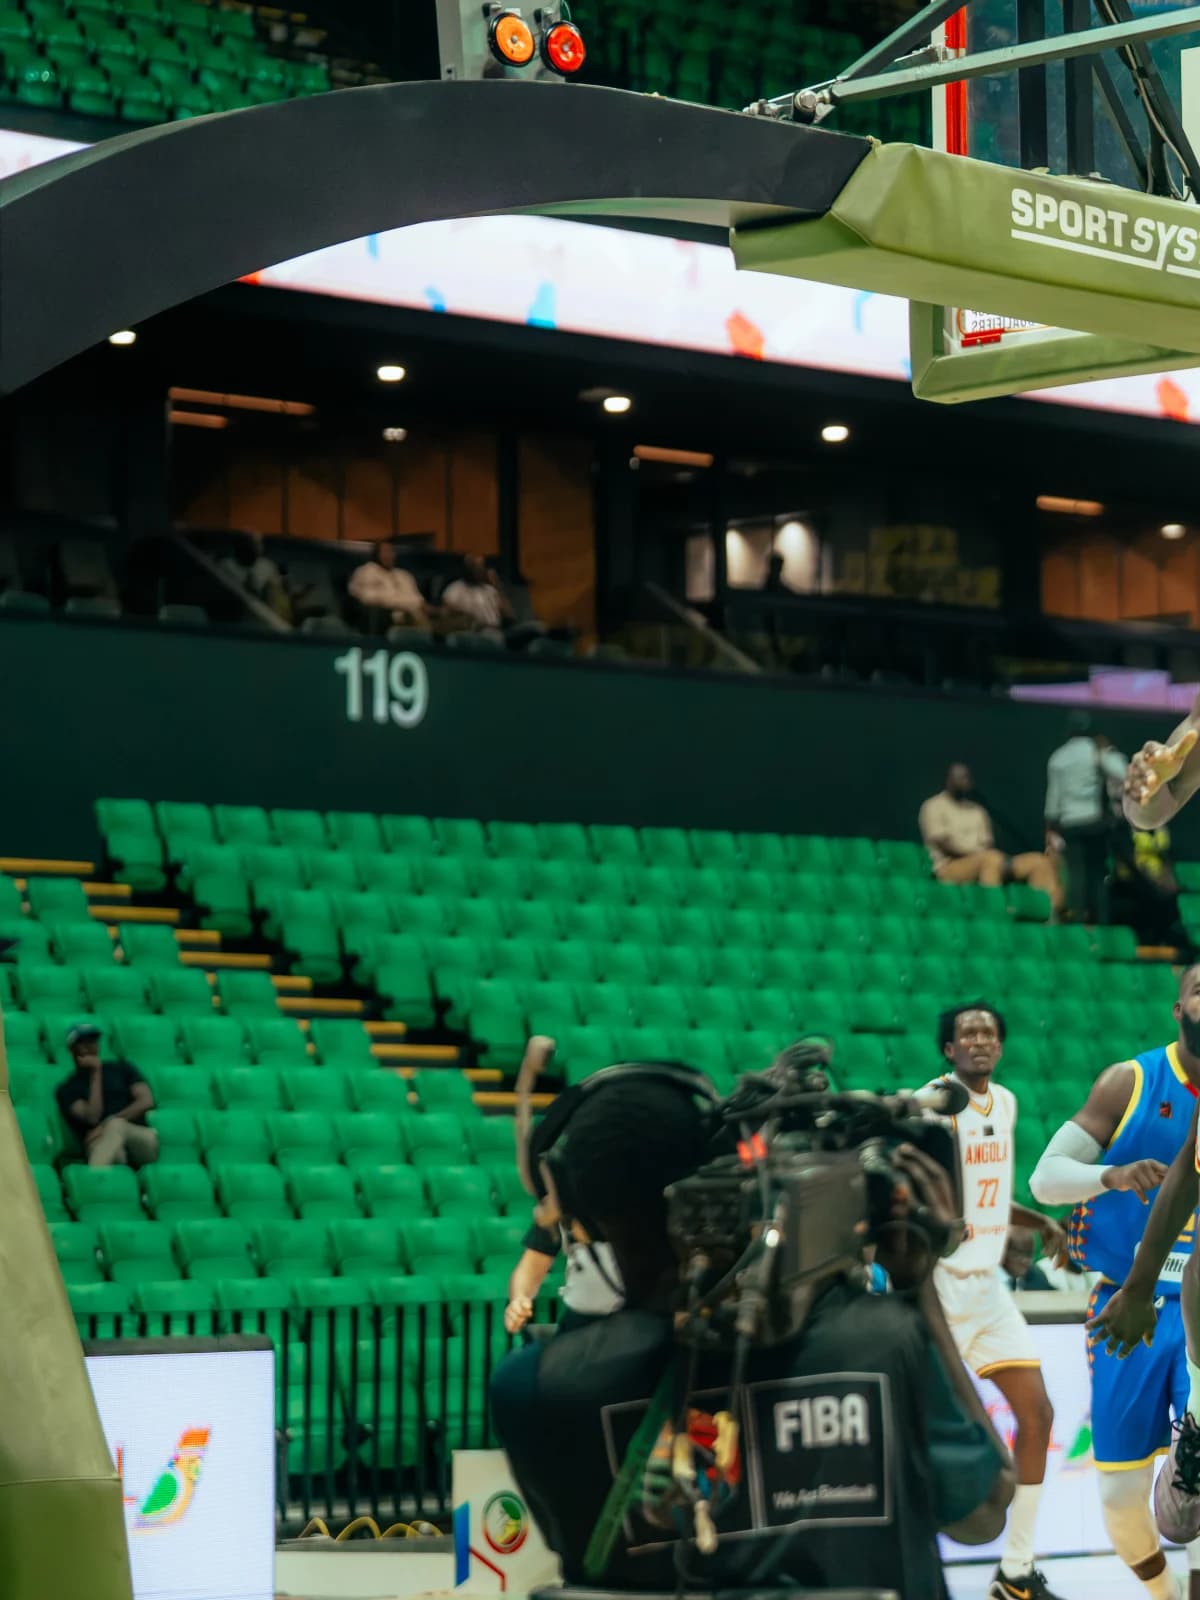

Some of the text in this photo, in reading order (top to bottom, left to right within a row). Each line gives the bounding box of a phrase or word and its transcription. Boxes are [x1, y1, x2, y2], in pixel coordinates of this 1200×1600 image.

[1010, 187, 1128, 248] SPORT
[334, 646, 429, 728] 119
[976, 1178, 999, 1208] 77
[773, 1392, 871, 1453] FIBA
